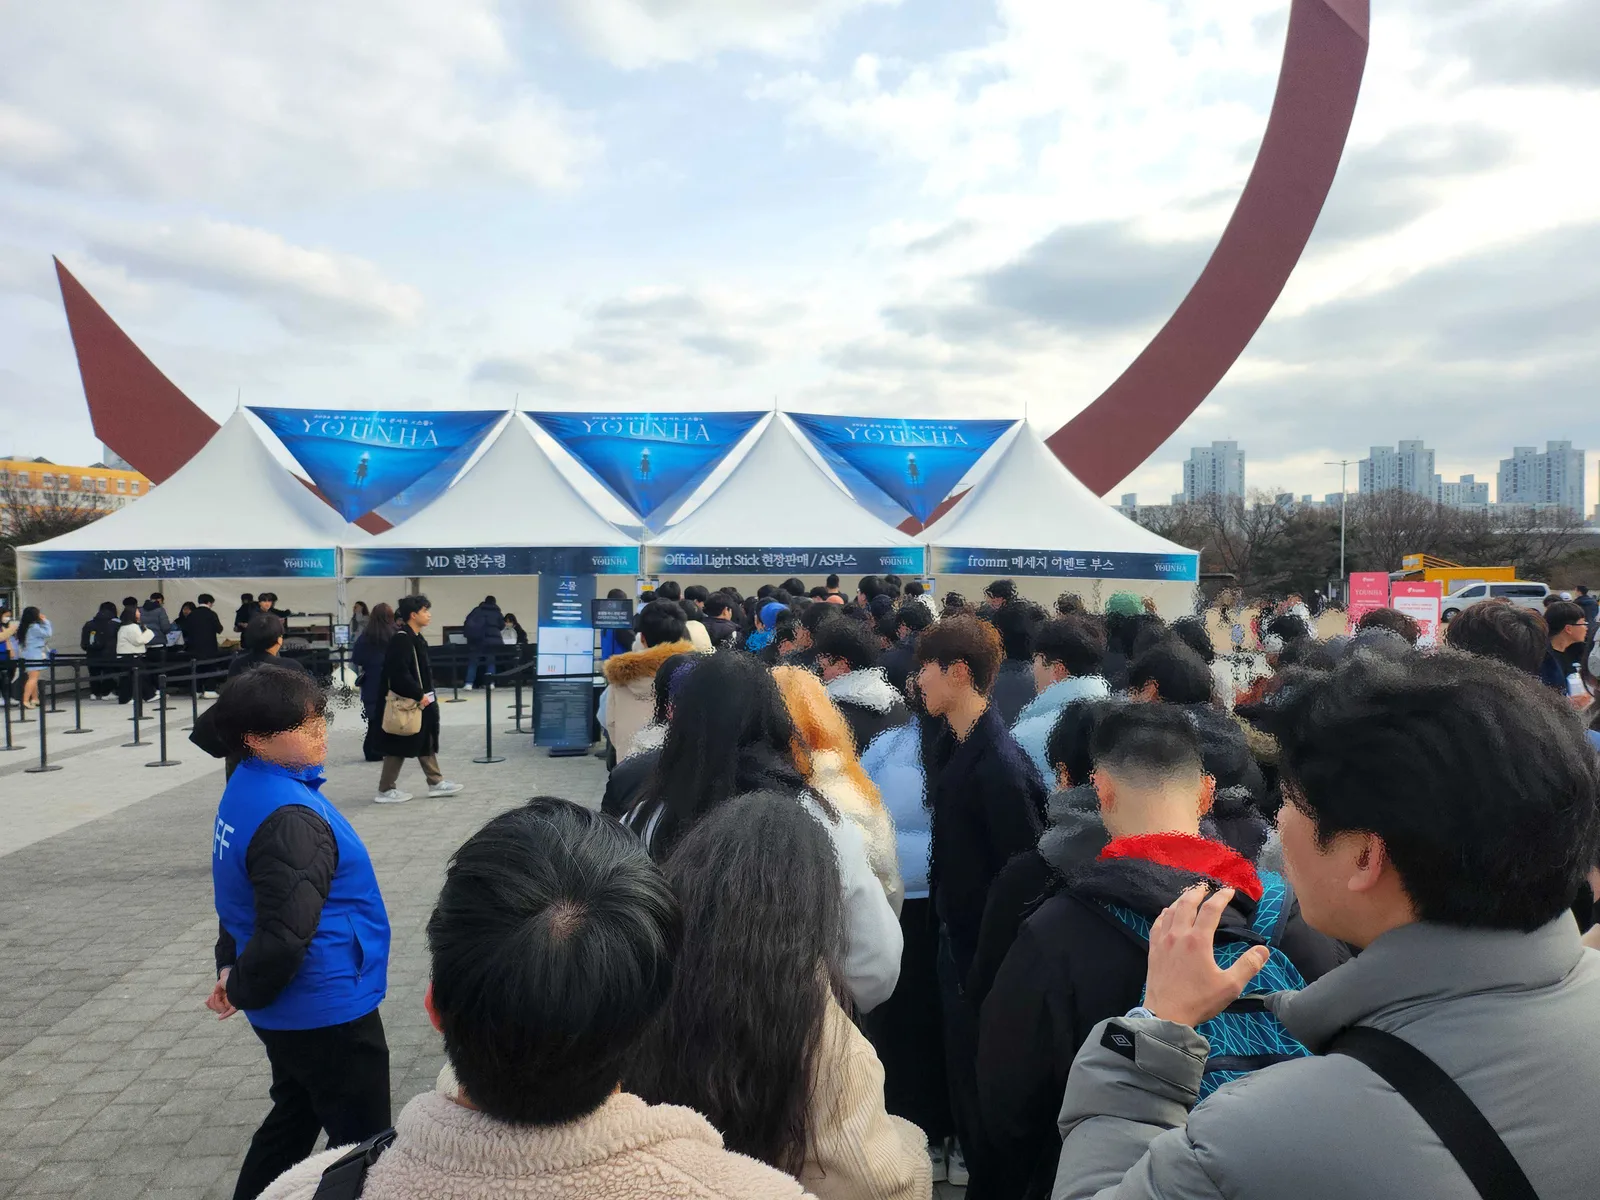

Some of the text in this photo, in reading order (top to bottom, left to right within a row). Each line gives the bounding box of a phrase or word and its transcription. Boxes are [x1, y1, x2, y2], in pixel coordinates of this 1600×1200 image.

[303, 418, 438, 446] YOUNHA
[582, 420, 710, 441] YOUNHA
[844, 427, 968, 445] YOUNHA
[104, 556, 191, 572] MD 현장판매
[283, 559, 323, 568] YOUNHA
[426, 554, 506, 569] MD 현장수령
[592, 557, 628, 565] YOUNHA
[664, 554, 703, 566] Official
[705, 554, 732, 567] Light
[734, 554, 759, 566] Stick
[762, 554, 809, 567] 현장판매
[818, 554, 858, 567] AS부스
[879, 558, 914, 566] YOUNHA
[968, 555, 1008, 568] fromm
[1011, 556, 1047, 569] 메세지
[1090, 558, 1115, 571] 부스
[1154, 563, 1187, 573] YOUNHA
